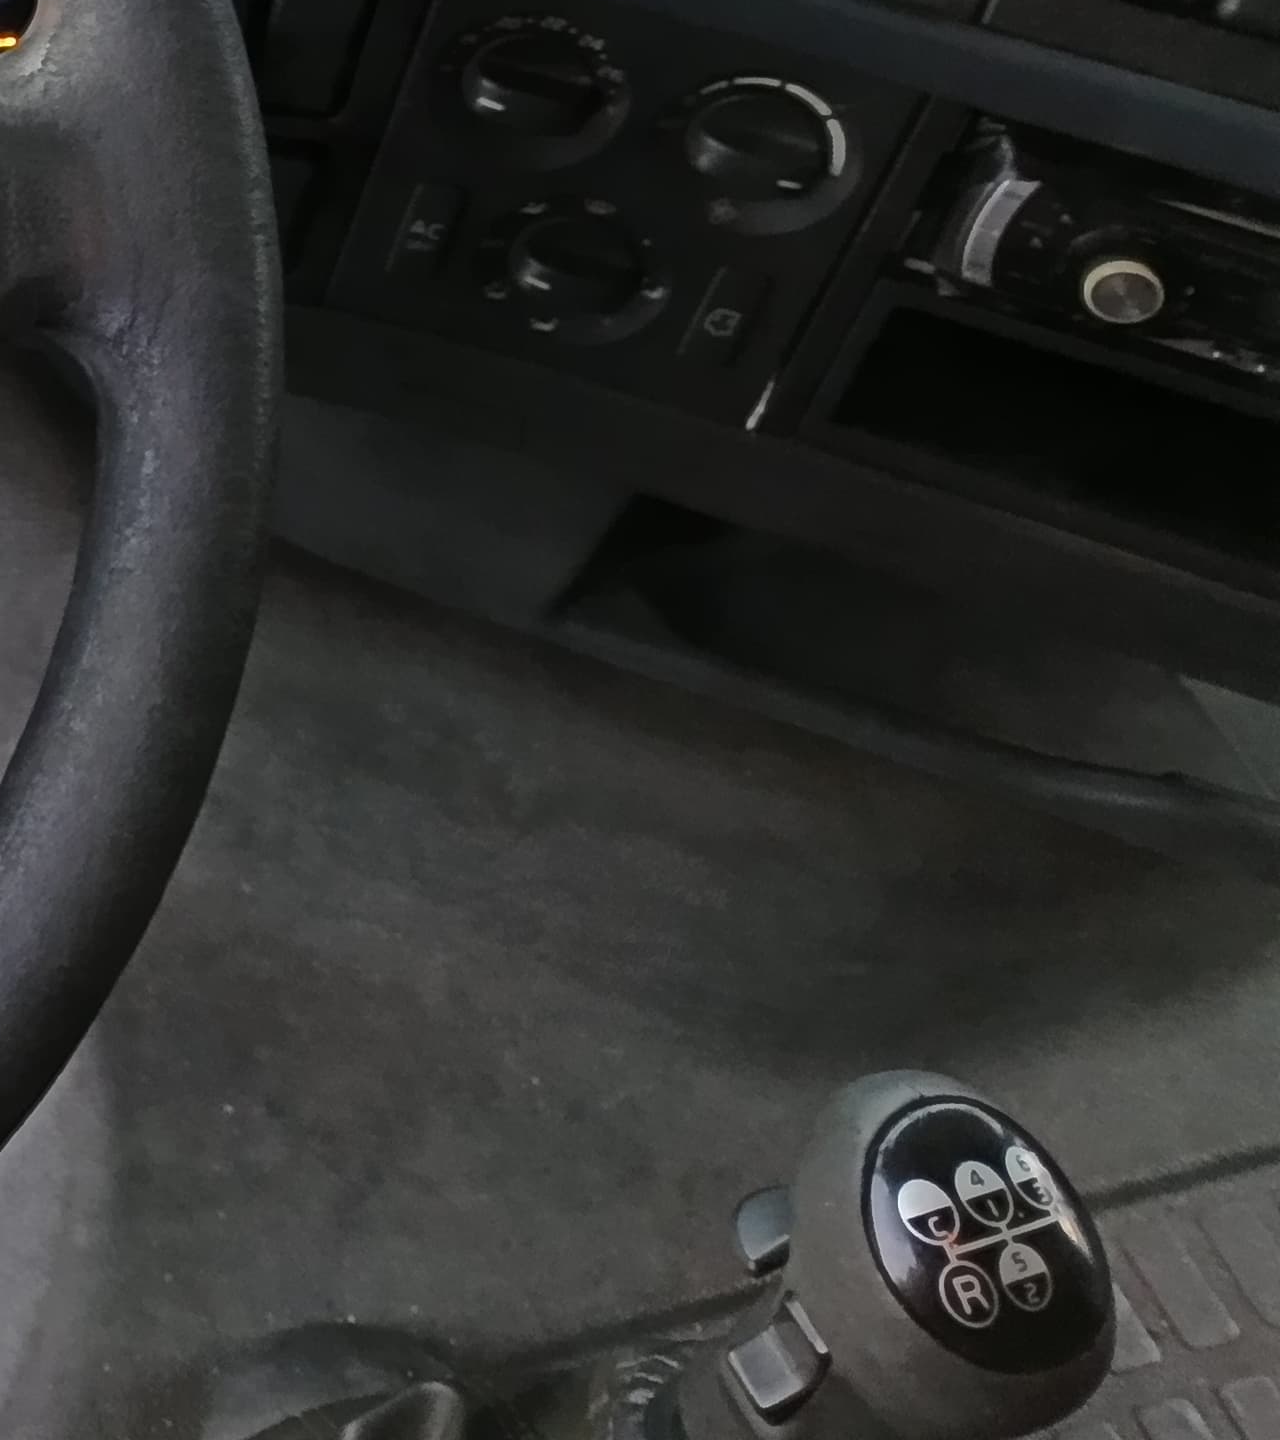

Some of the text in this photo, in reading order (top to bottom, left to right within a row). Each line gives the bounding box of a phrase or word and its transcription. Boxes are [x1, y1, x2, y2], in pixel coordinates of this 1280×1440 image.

[969, 1168, 985, 1187] 4
[986, 1198, 1000, 1217] 1
[1011, 1251, 1028, 1273] 5
[952, 1274, 989, 1315] R
[1023, 1282, 1039, 1304] 2
